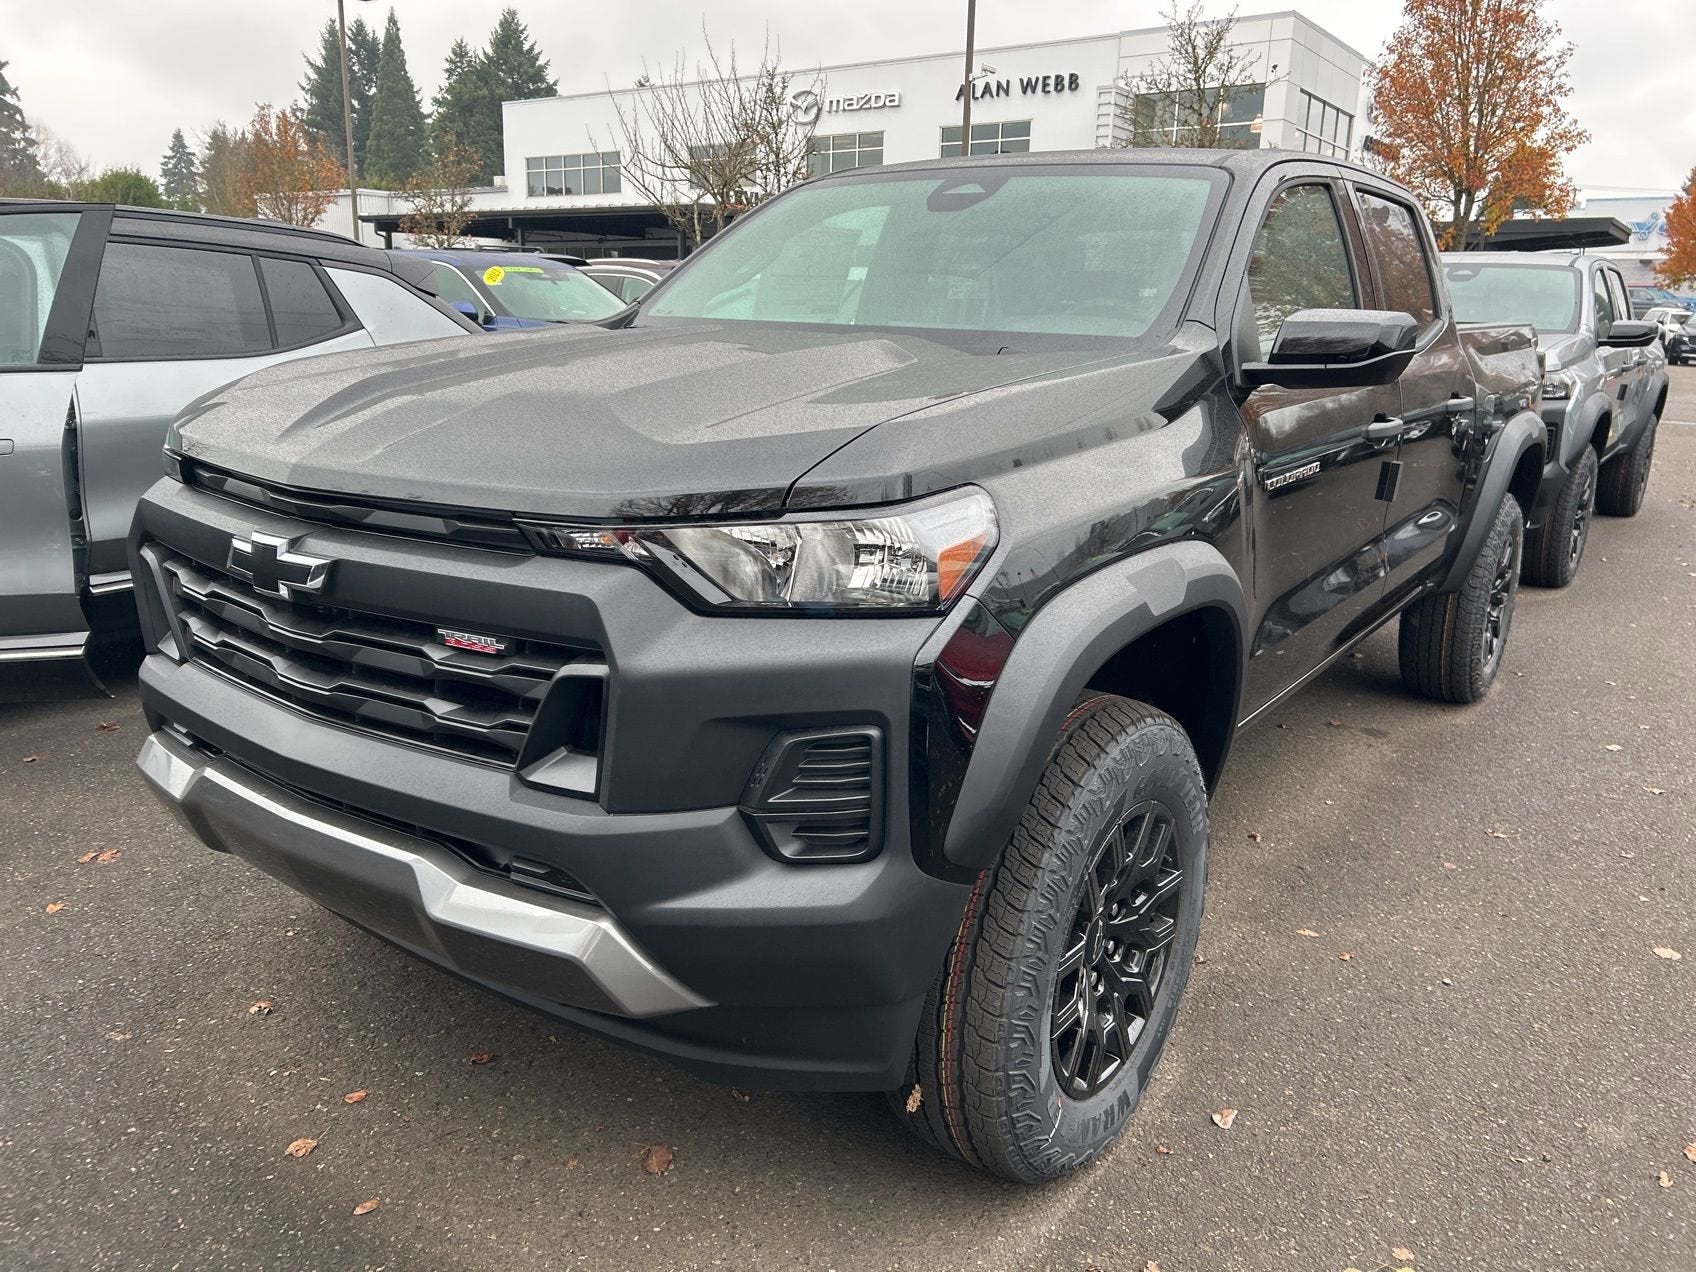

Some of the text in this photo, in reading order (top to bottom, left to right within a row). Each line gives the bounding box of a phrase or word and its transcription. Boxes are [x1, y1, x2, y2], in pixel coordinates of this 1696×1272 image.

[955, 72, 1080, 101] ALAN WEBB
[437, 628, 505, 650] TRAIL
